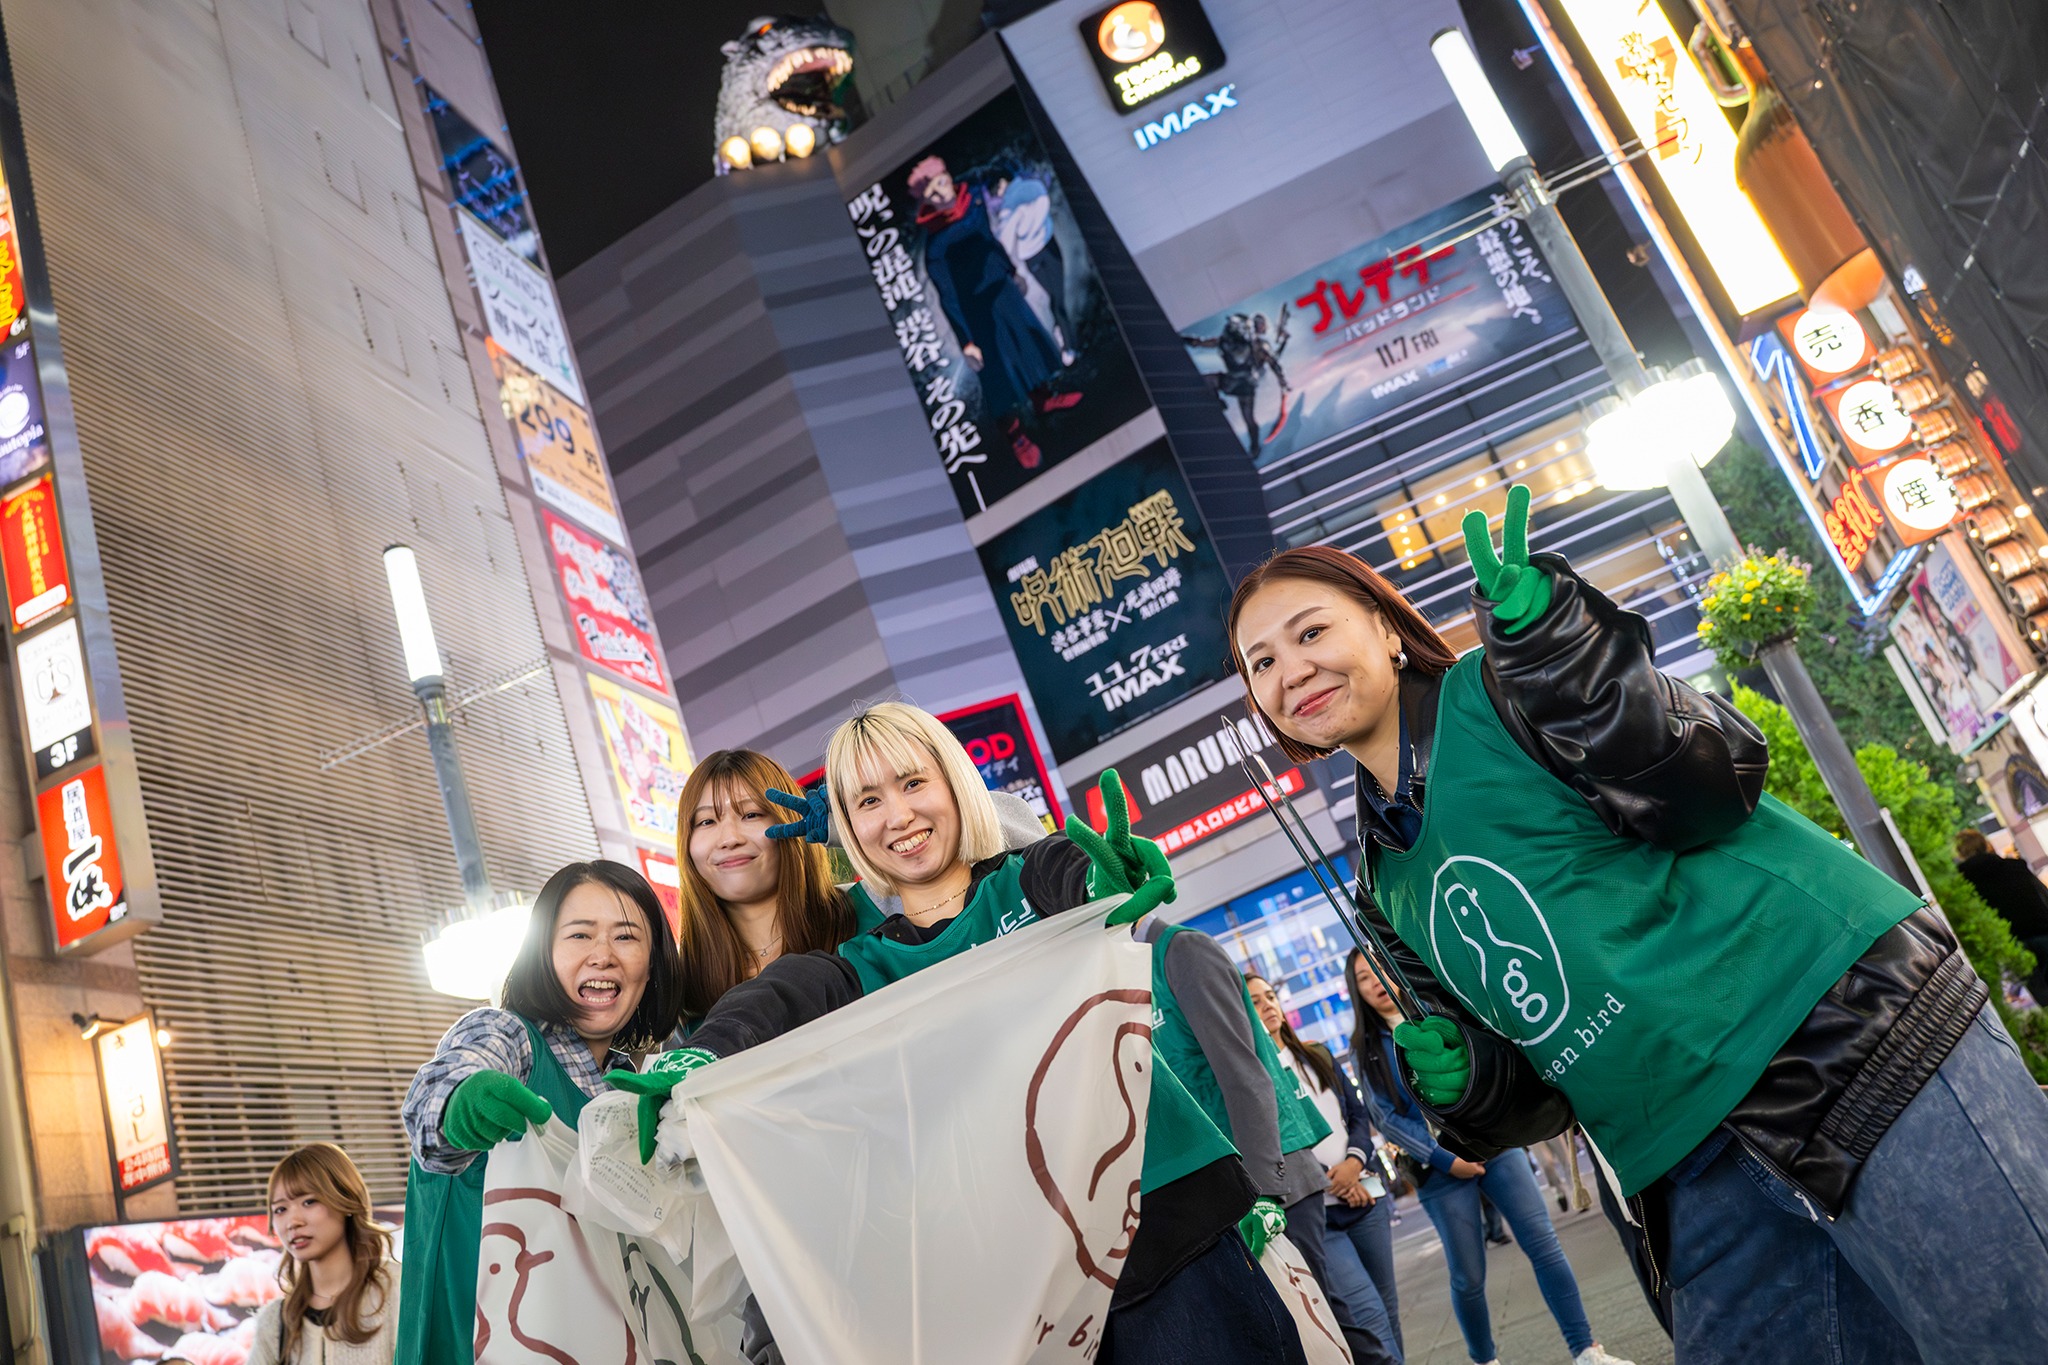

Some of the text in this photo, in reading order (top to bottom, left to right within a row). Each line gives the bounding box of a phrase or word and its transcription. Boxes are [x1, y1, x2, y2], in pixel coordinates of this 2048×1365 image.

[1133, 86, 1238, 150] IMAX
[1296, 245, 1456, 334] プレデター
[1375, 335, 1409, 369] 11.7
[1413, 327, 1440, 355] FRI
[1370, 371, 1420, 399] IMAX
[1102, 653, 1187, 713] IMAX
[50, 735, 79, 768] 3F
[1541, 992, 1626, 1083] reen bird
